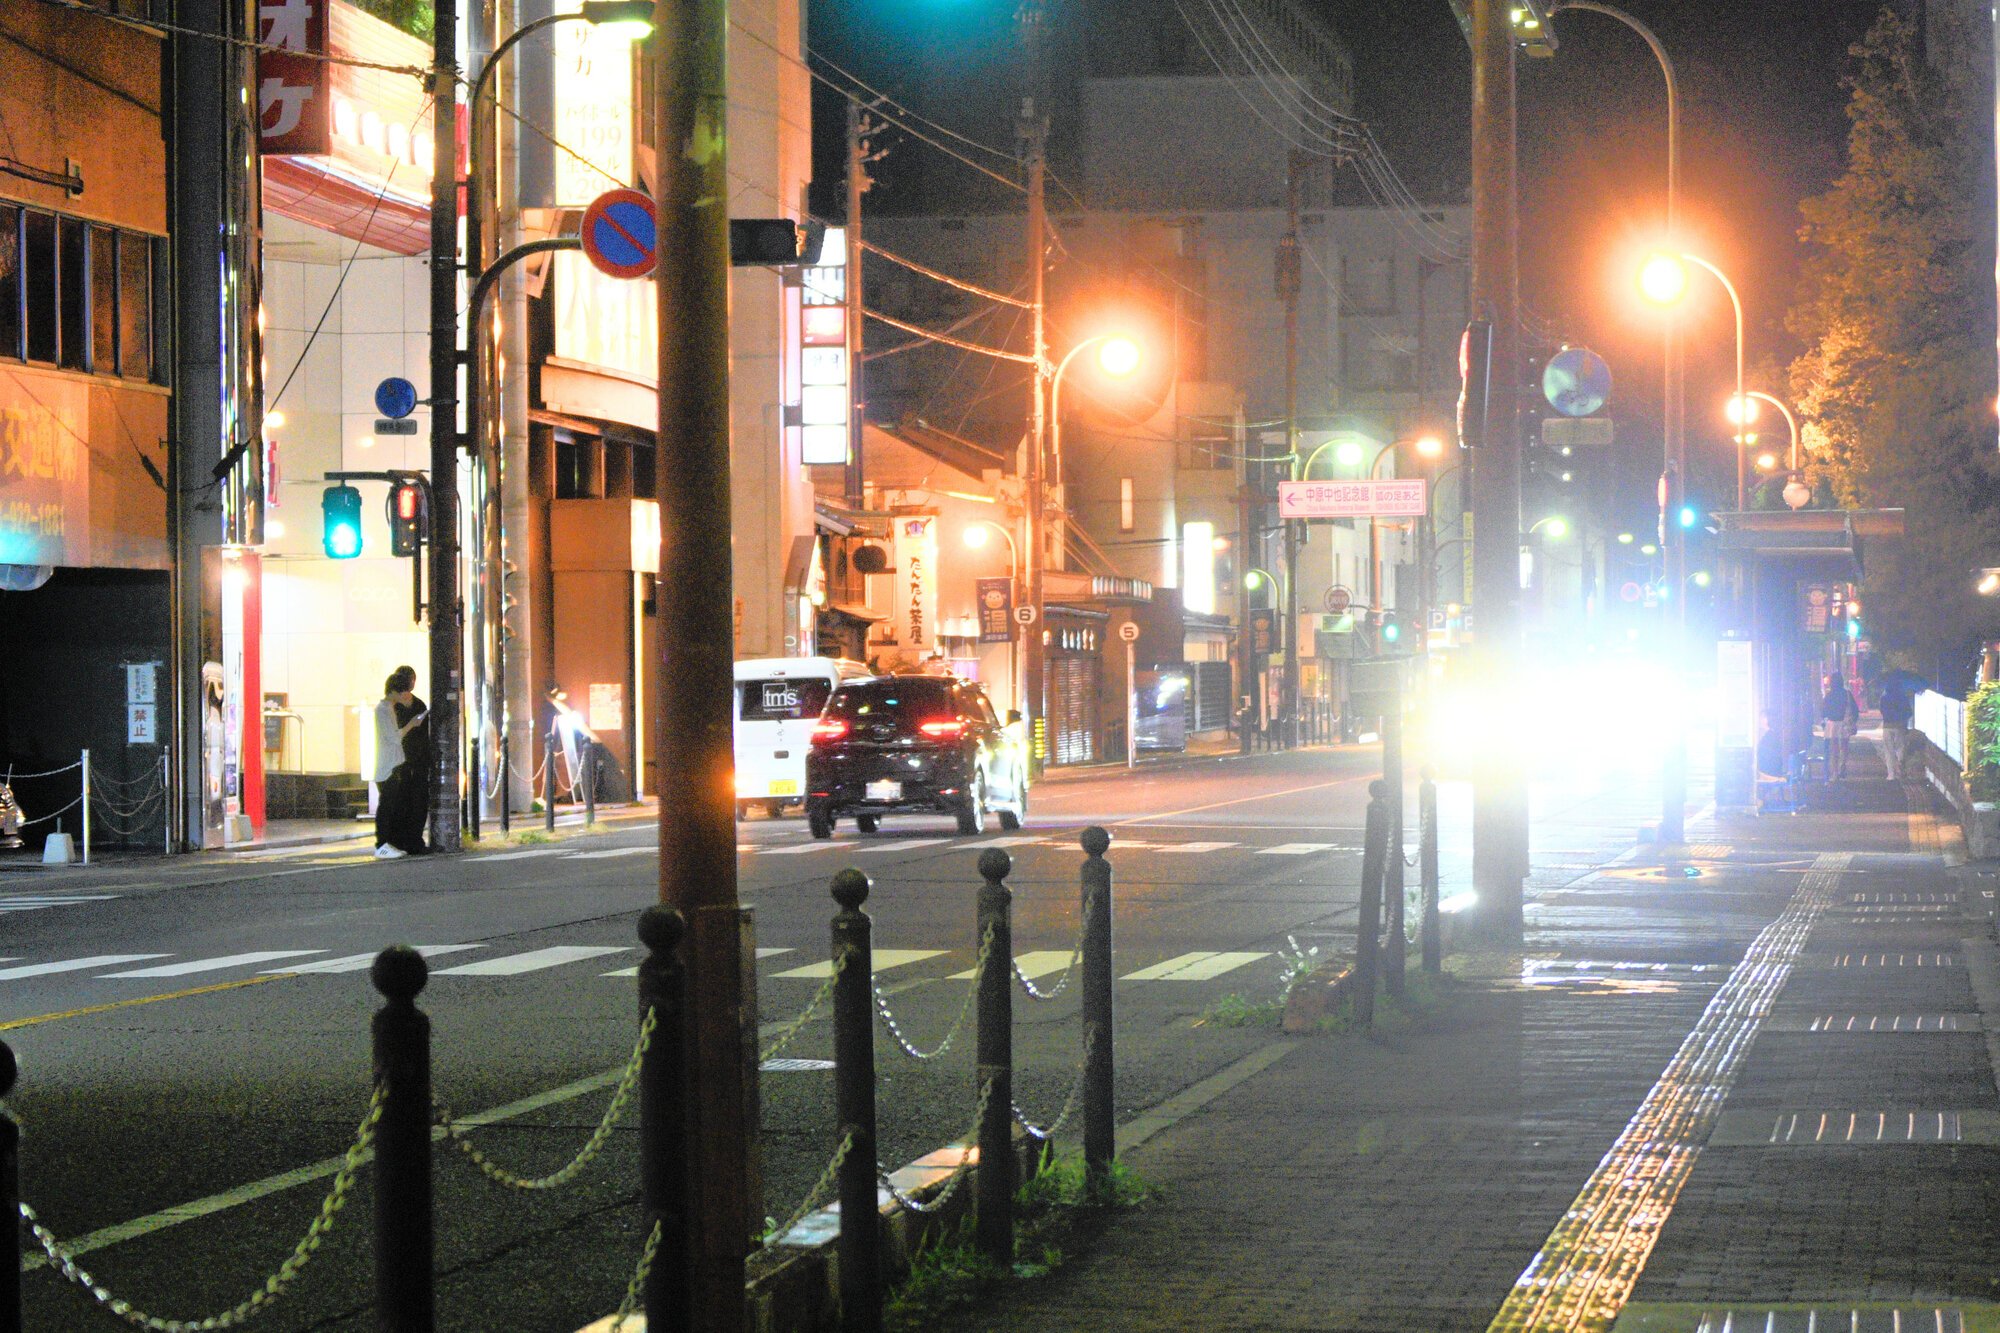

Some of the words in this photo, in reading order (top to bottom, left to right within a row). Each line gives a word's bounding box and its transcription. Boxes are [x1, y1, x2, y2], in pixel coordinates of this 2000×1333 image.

[1306, 487, 1370, 502] 中原中也記念館
[1019, 608, 1032, 622] 6
[1433, 612, 1444, 626] P
[1123, 626, 1135, 638] 5
[765, 689, 797, 706] tms
[133, 709, 148, 737] 禁止
